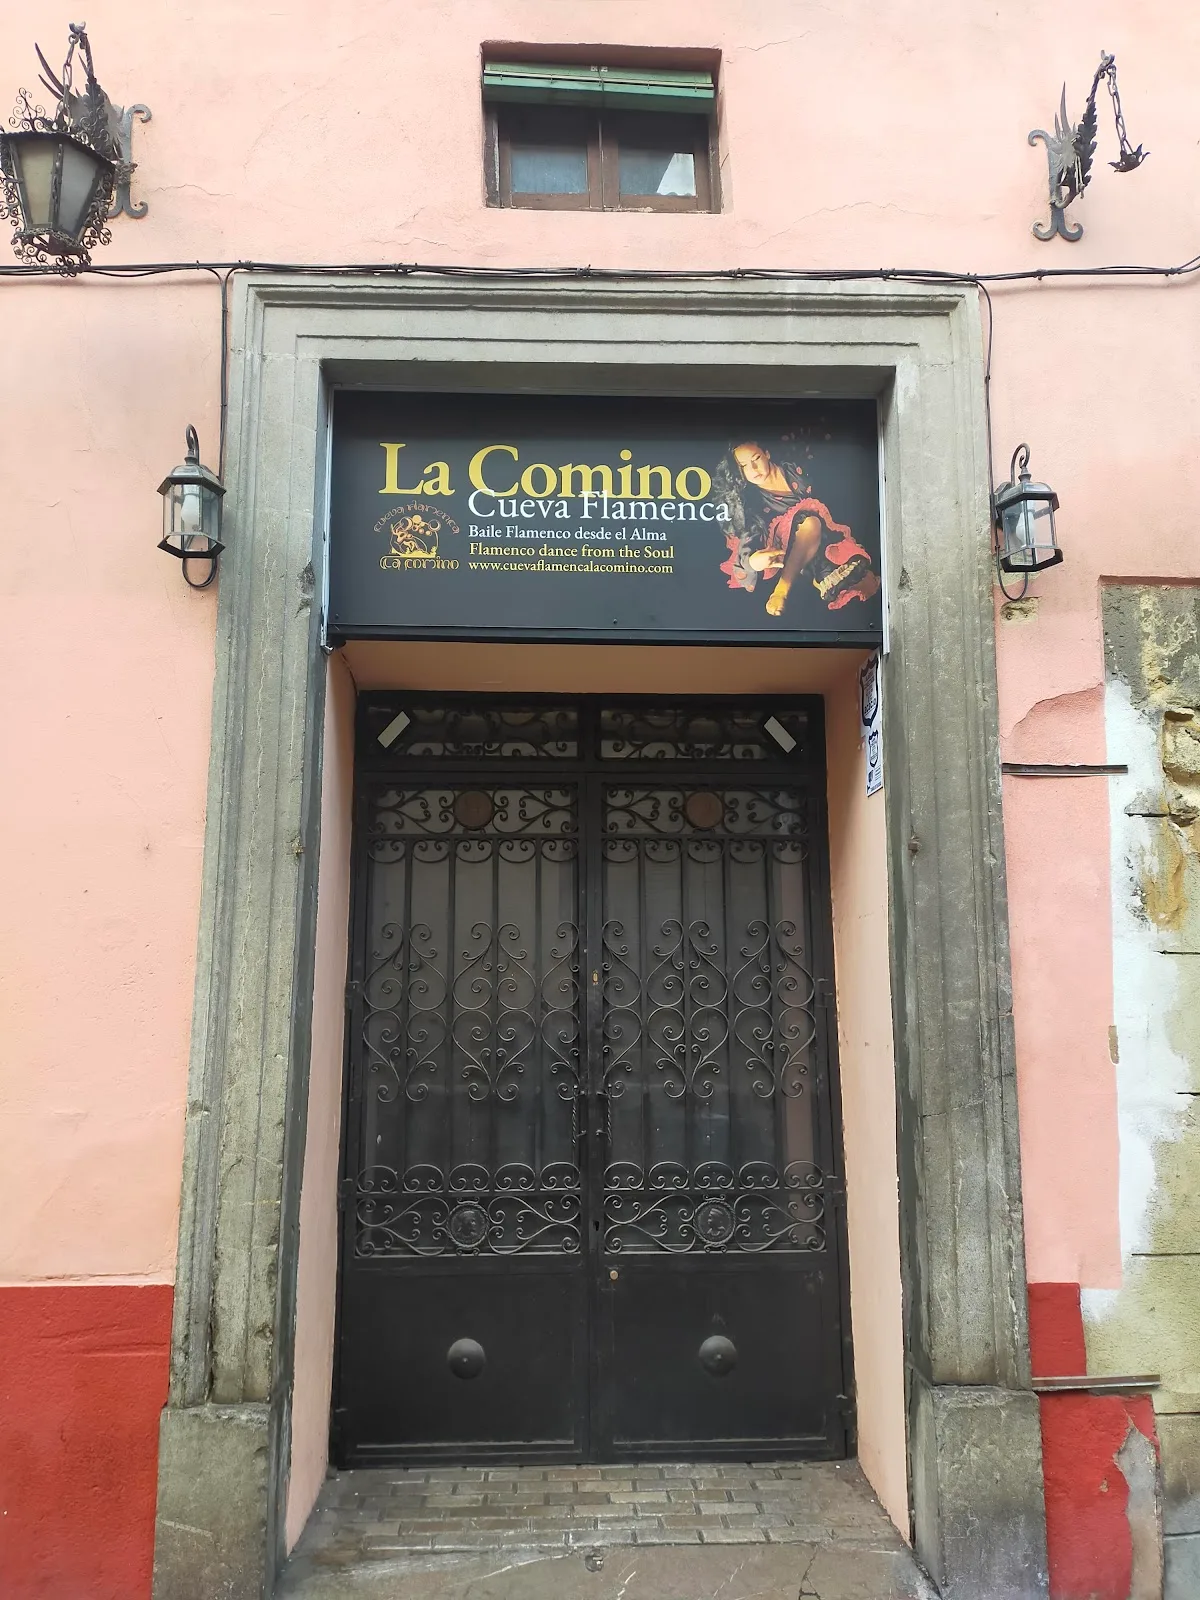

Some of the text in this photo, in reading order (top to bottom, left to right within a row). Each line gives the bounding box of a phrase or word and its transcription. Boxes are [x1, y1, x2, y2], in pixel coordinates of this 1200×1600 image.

[378, 442, 712, 501] La Comino
[468, 488, 732, 523] Cueva Flamenca
[468, 524, 668, 541] Baile Flamenco desde el Alma
[469, 542, 675, 559] Flamenco dance from the Soul
[468, 559, 674, 574] www.cuevaflamencalacomino.com
